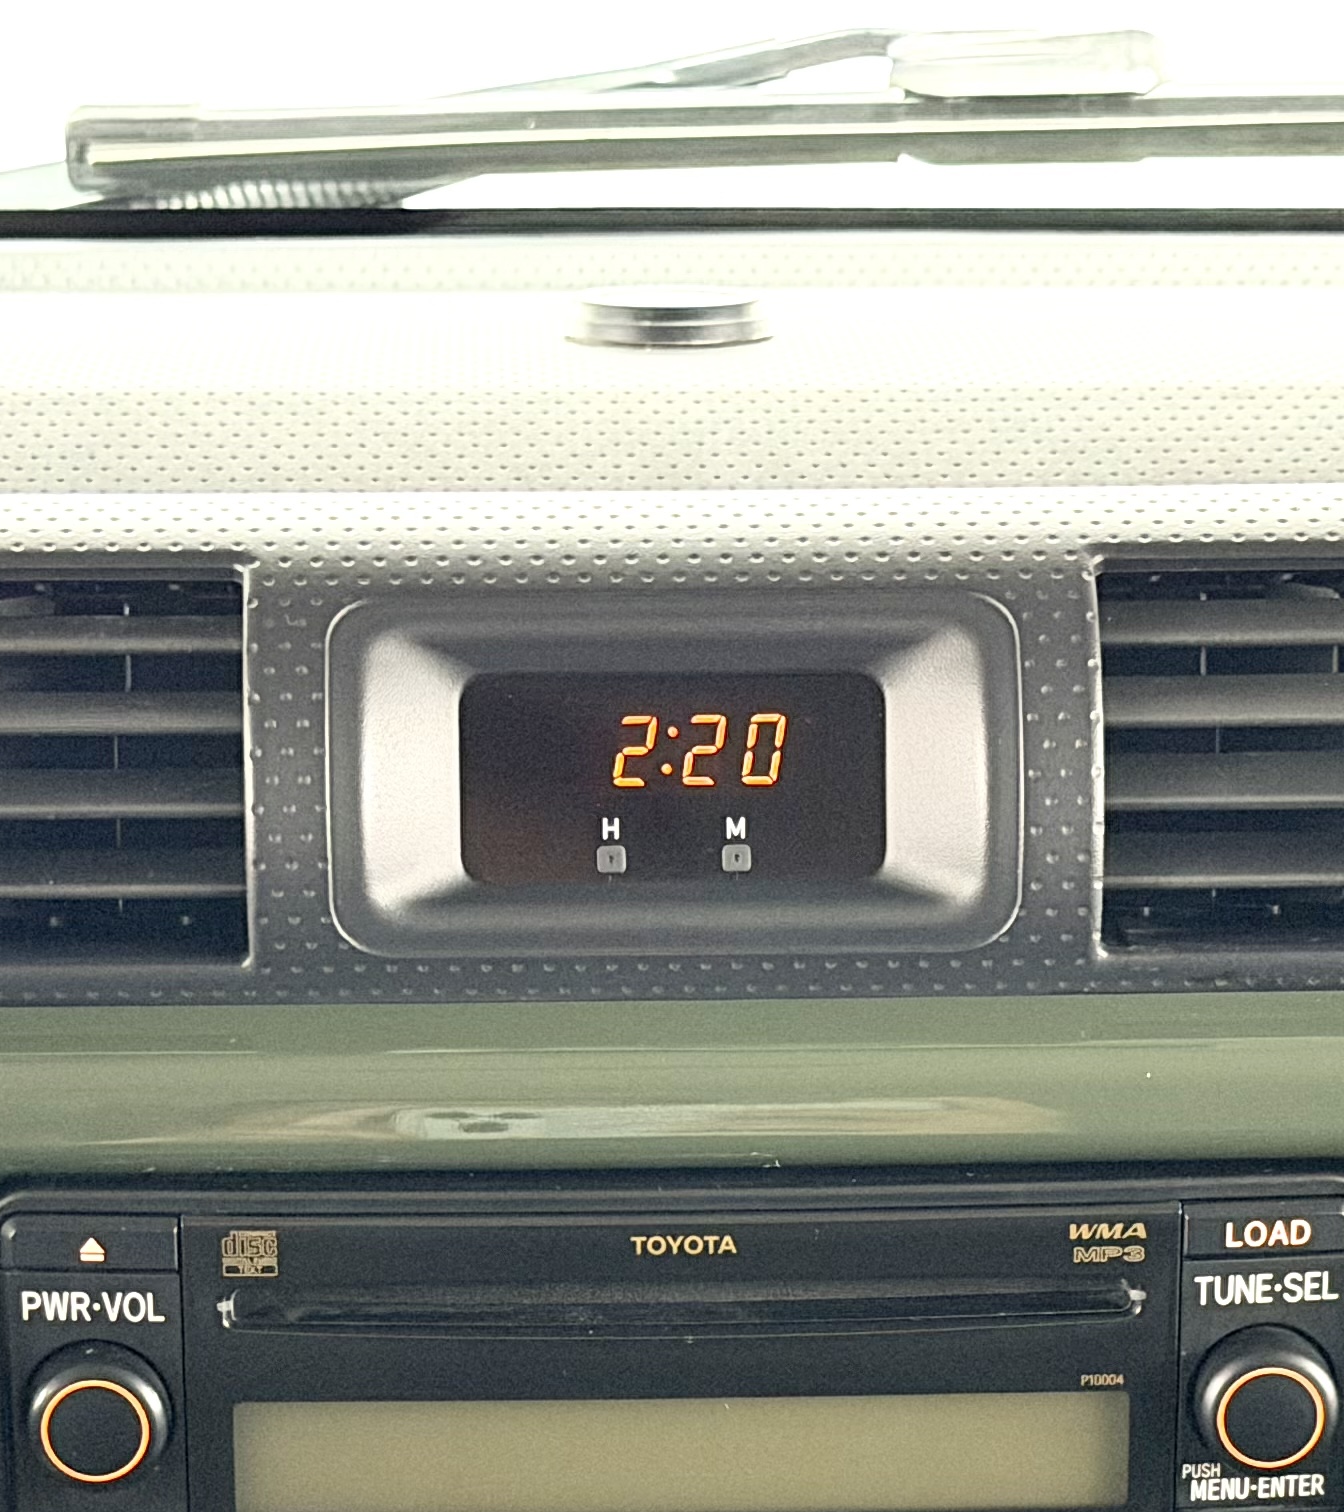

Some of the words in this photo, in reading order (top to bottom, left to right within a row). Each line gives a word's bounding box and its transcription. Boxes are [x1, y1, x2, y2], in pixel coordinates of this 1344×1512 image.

[612, 713, 786, 787] 2:20
[602, 817, 619, 840] H
[726, 816, 746, 840] M
[1068, 1222, 1147, 1240] WMA
[1224, 1220, 1312, 1248] LOAD
[630, 1235, 737, 1256] TOYOTA
[1072, 1245, 1146, 1263] MP3
[1080, 1374, 1125, 1387] P10004
[1182, 1463, 1222, 1480] PUSH
